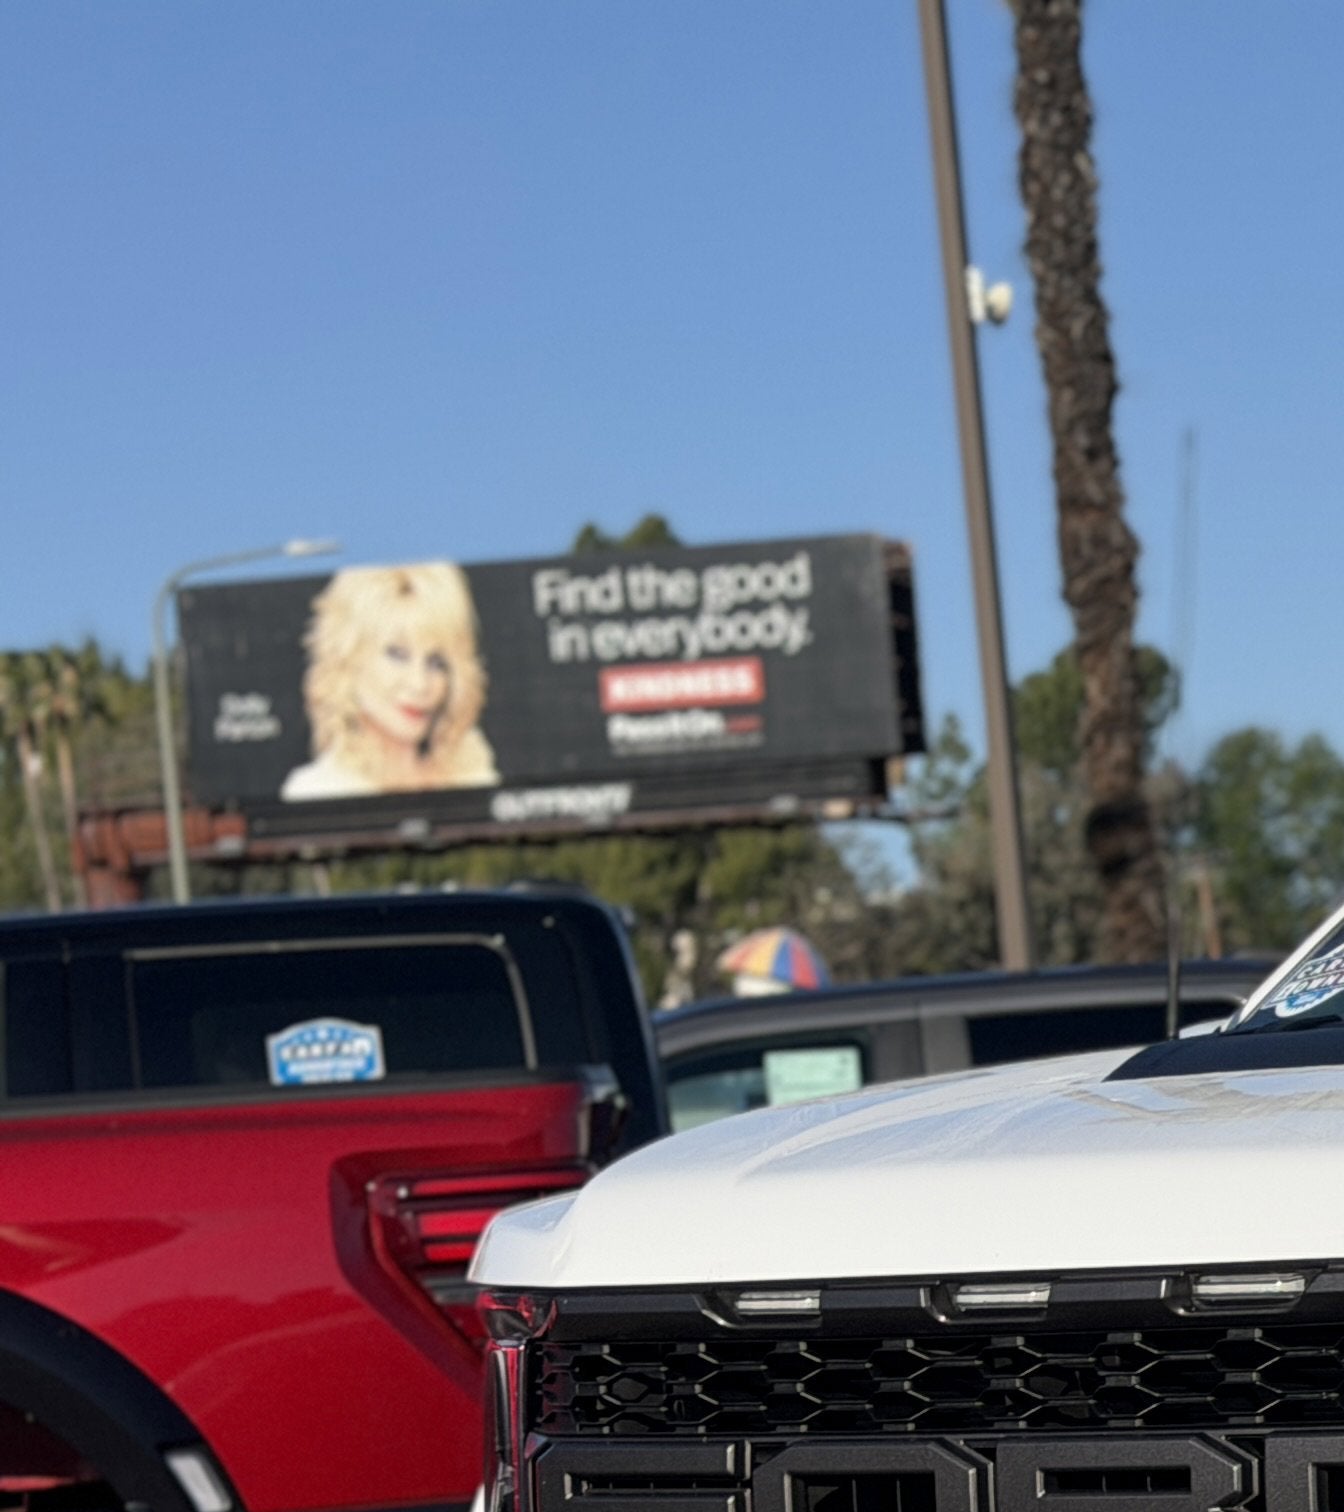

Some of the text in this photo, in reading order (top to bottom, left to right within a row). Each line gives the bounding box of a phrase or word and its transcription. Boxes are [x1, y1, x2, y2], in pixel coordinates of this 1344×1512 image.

[533, 552, 812, 617] Find the good
[550, 604, 813, 663] in everybody.
